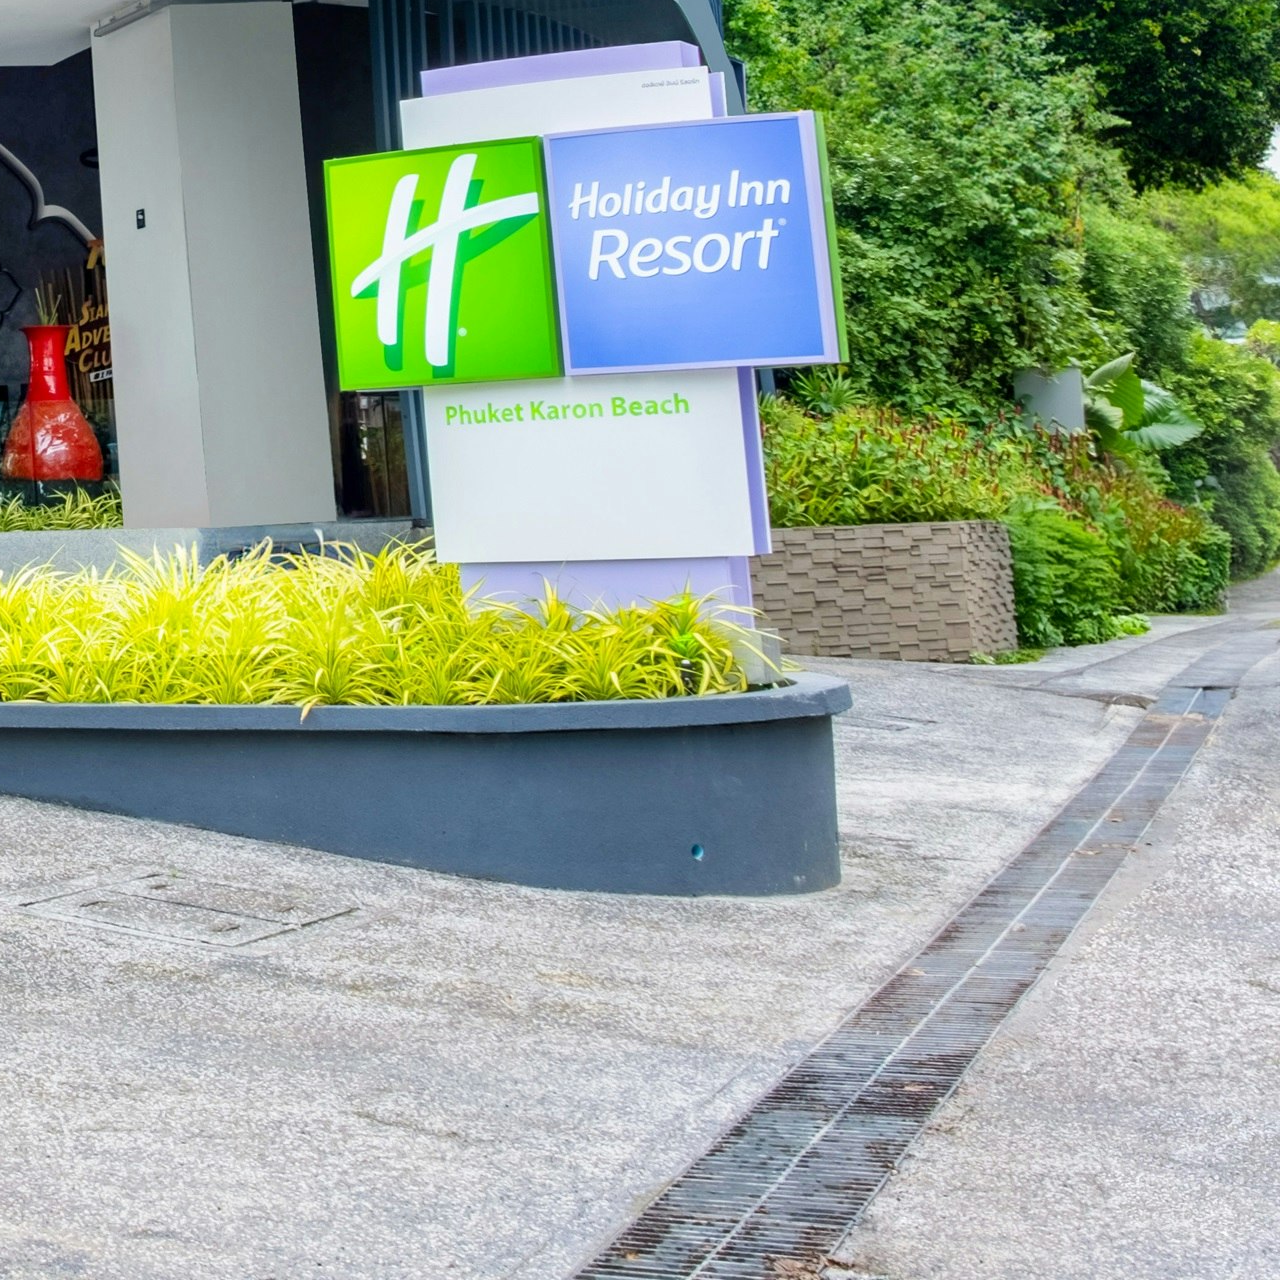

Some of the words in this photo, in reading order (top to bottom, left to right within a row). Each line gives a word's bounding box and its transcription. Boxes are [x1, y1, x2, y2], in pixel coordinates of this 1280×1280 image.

[568, 176, 721, 220] Holiday
[727, 170, 791, 208] Inn
[588, 218, 780, 281] Resort
[445, 402, 524, 426] Phuket
[530, 400, 604, 421] Karon
[611, 392, 691, 417] Beach
